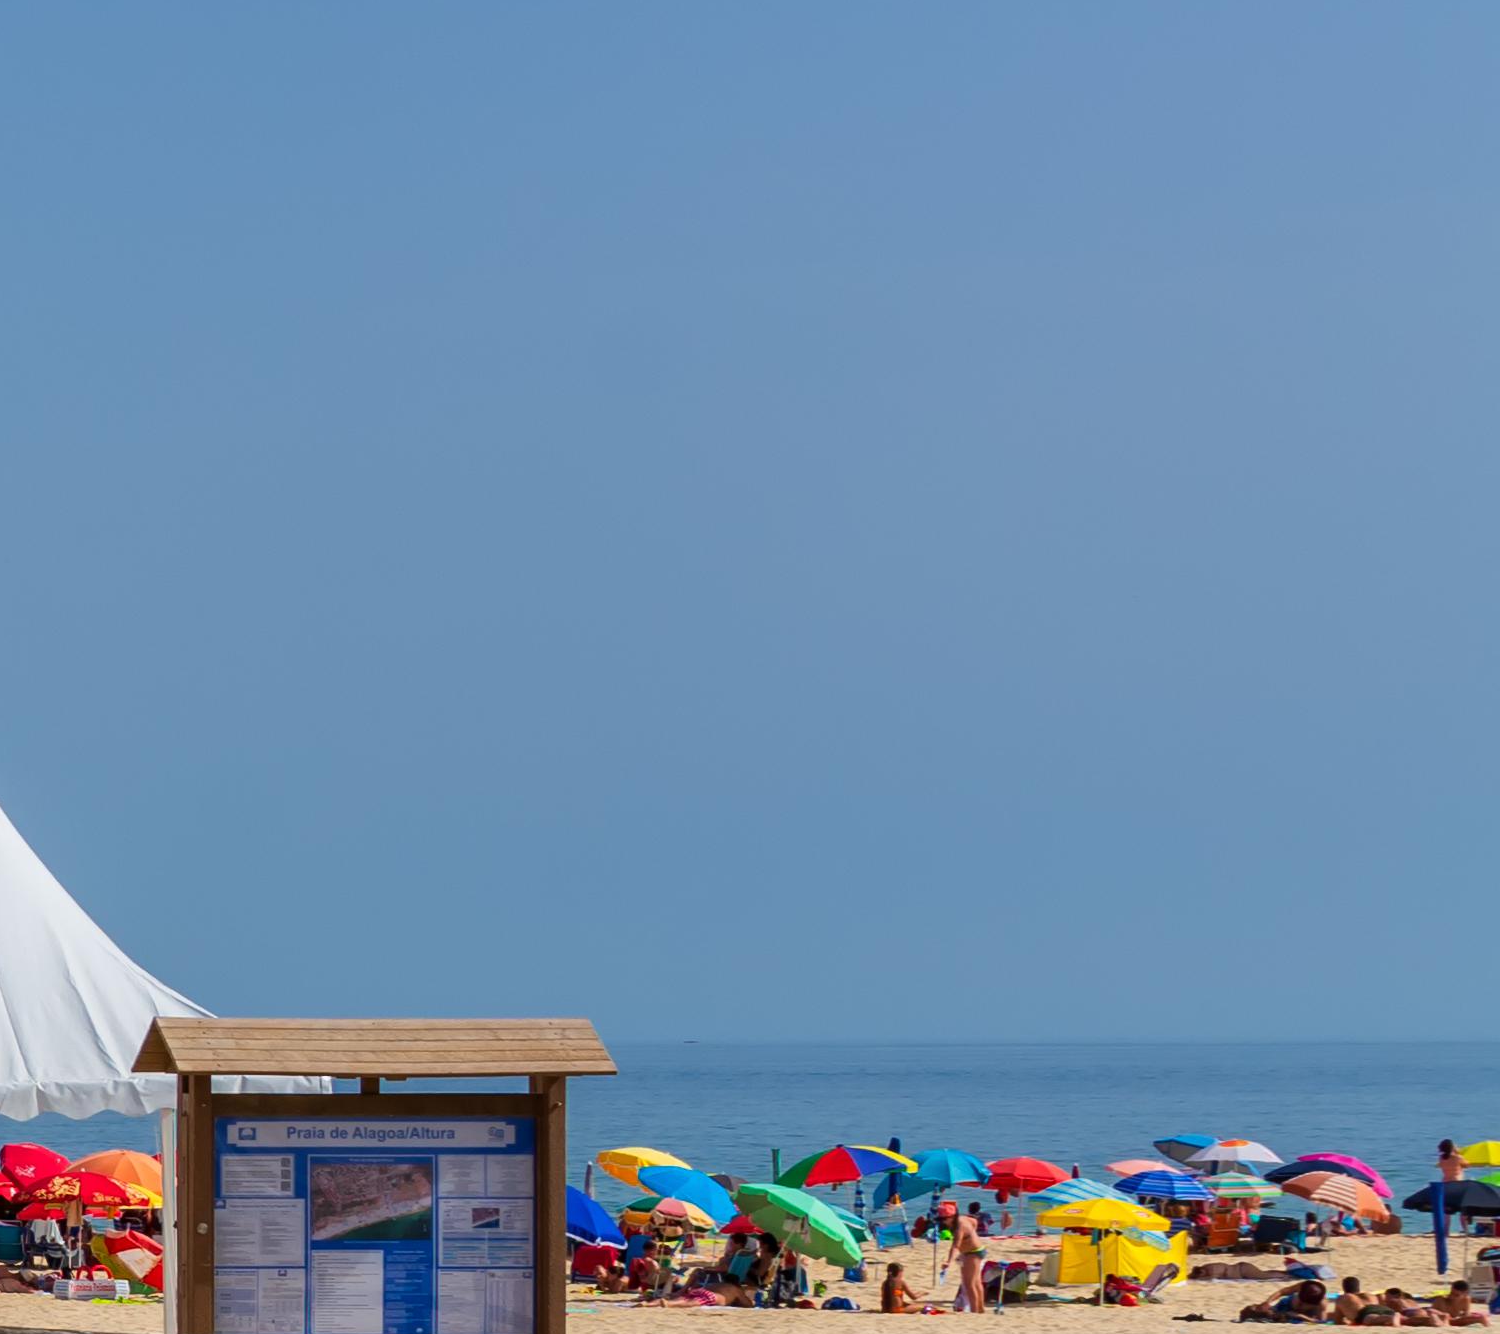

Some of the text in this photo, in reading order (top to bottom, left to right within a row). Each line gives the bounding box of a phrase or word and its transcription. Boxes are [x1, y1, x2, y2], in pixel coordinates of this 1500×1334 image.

[286, 1126, 456, 1142] Praia de Alagoa/Altura
